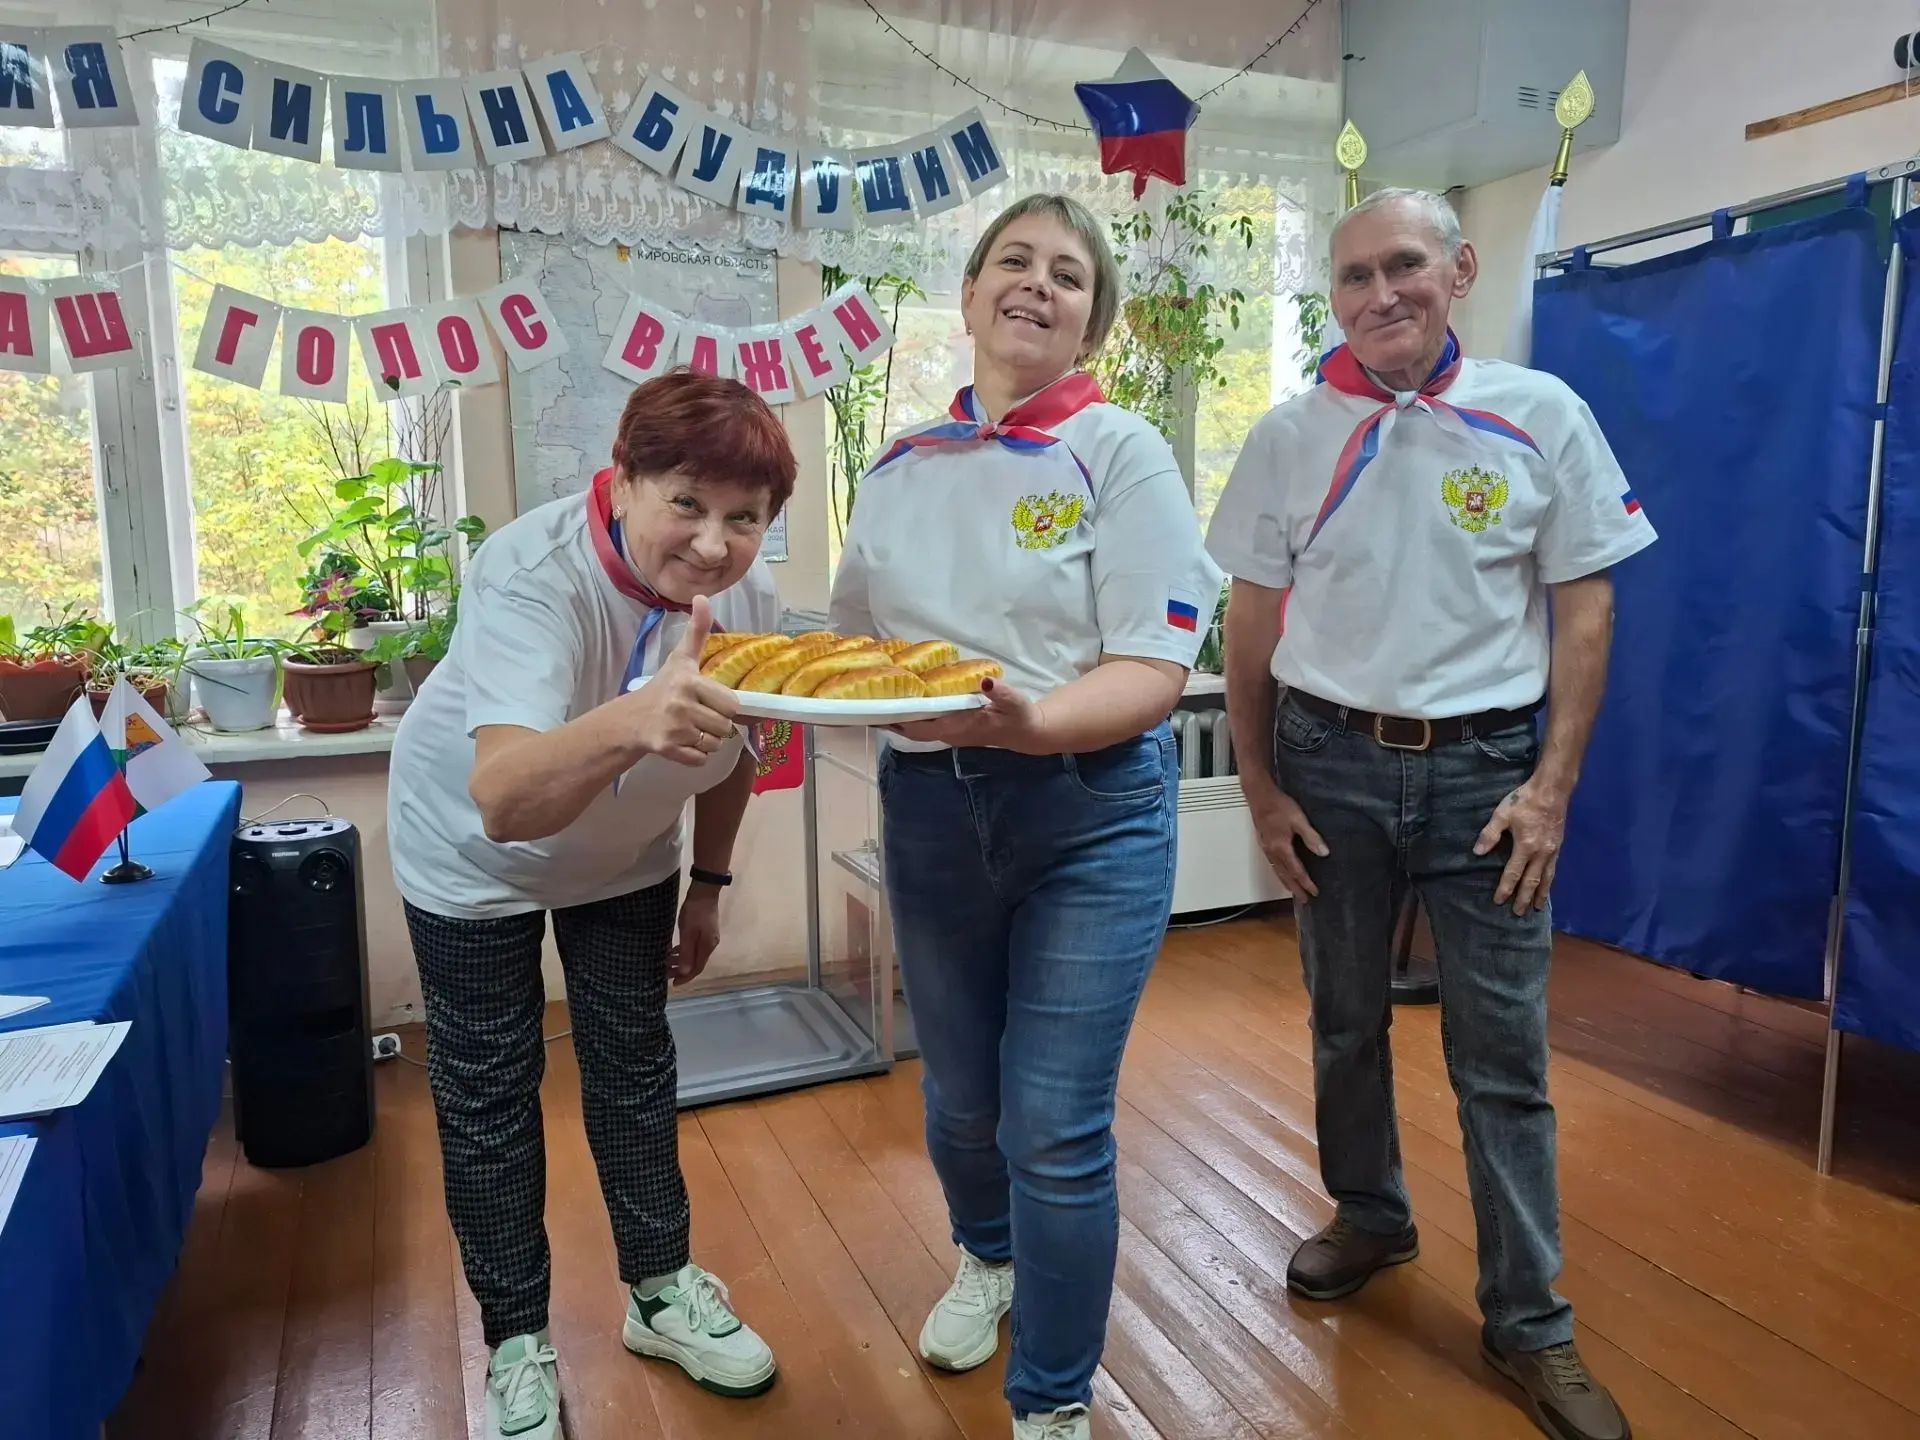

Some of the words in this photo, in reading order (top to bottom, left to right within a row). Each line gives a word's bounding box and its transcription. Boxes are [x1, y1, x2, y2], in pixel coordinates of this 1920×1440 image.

[198, 60, 594, 154] СИЛЬНА
[632, 91, 1001, 213] БУДУЩИМ
[637, 249, 711, 265] КИРОВСКАЯ
[714, 255, 769, 270] ОБЛАСТЬ
[215, 293, 548, 386] ГОЛОС
[621, 294, 882, 392] ВАЖЕН
